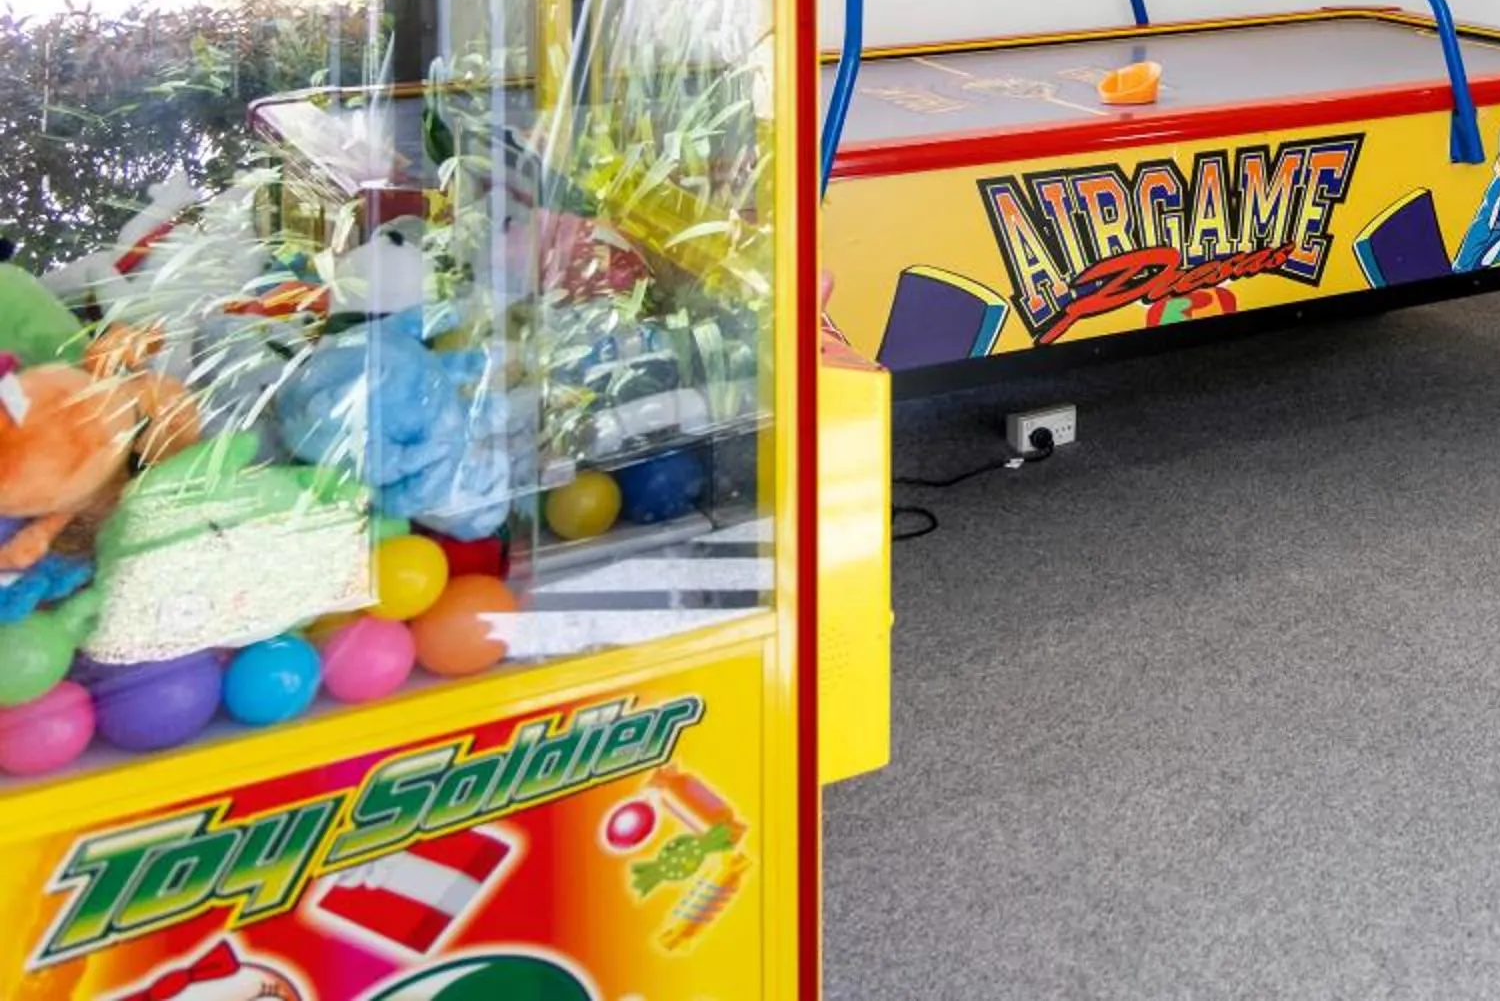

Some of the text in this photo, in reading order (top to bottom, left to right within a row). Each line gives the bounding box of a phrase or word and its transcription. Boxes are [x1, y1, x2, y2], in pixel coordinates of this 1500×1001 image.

[980, 135, 1364, 328] AIRGAME
[30, 695, 704, 965] Toy Soldier
